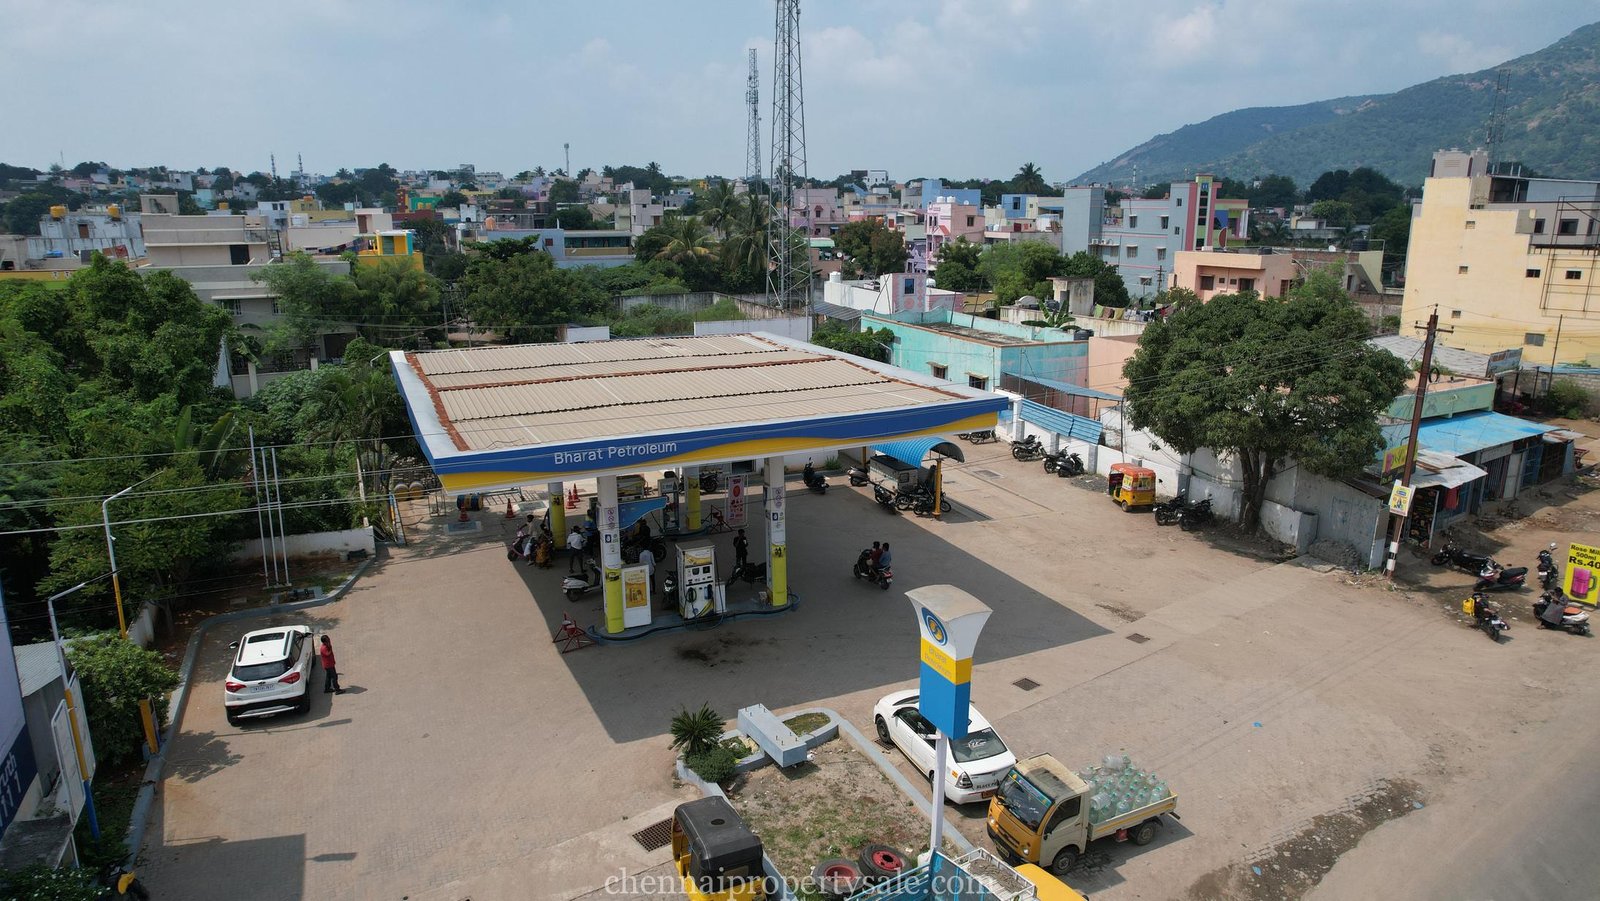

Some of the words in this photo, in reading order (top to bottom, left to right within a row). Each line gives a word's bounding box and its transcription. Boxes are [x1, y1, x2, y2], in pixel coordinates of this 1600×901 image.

[554, 448, 604, 465] Bharat
[608, 442, 677, 459] Petroleum
[1571, 544, 1588, 552] Rose
[1569, 555, 1600, 569] Rs.40
[1576, 551, 1597, 561] 500ml
